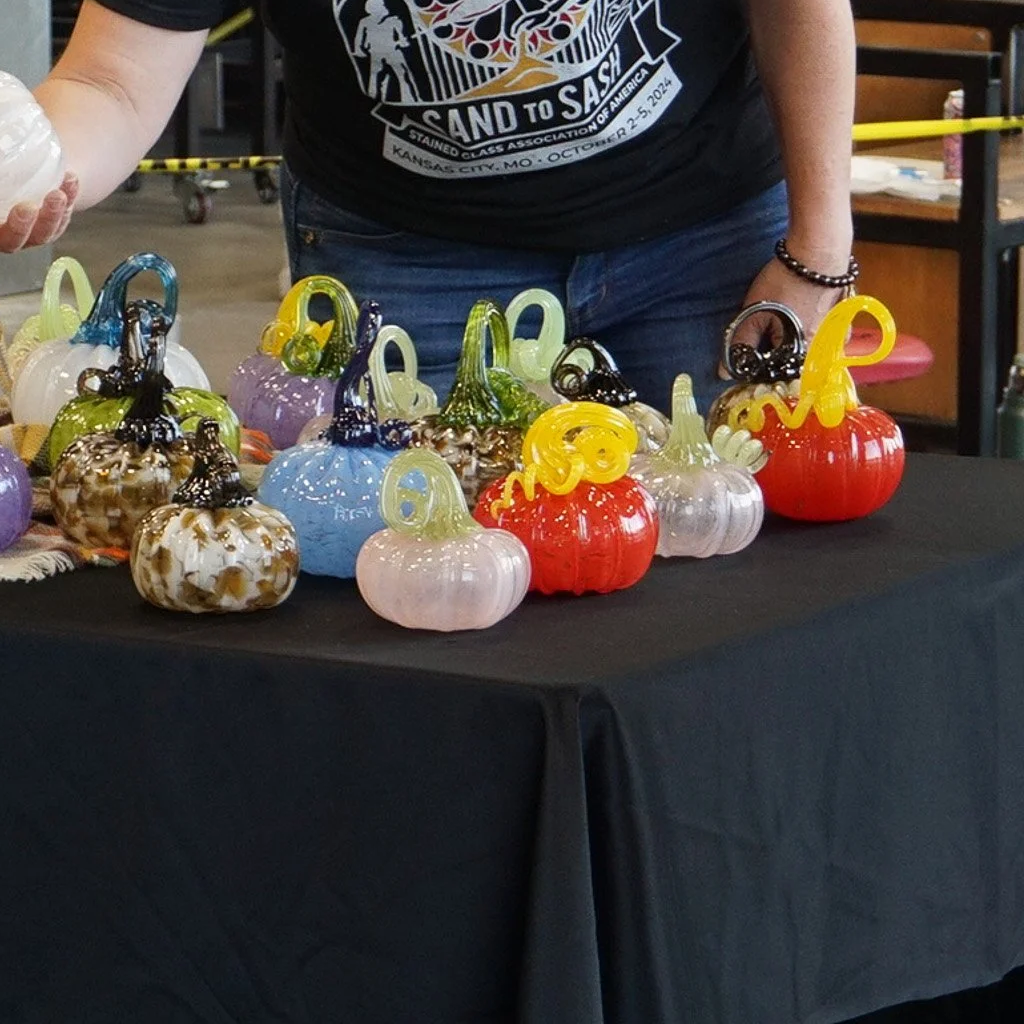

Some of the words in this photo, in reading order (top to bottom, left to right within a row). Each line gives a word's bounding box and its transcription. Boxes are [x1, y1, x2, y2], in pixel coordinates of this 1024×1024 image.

[392, 144, 454, 174] KANSAS
[504, 158, 532, 170] MO
[547, 127, 627, 163] OCTOBER
[647, 76, 673, 107] 2024
[408, 129, 459, 156] STAINED
[460, 144, 505, 160] GLASS
[507, 122, 598, 150] ASSOCIATION
[596, 107, 611, 125] OF
[609, 67, 650, 112] AMERICA
[422, 101, 518, 143] SAND
[523, 99, 554, 123] TO
[557, 43, 622, 120] SASH
